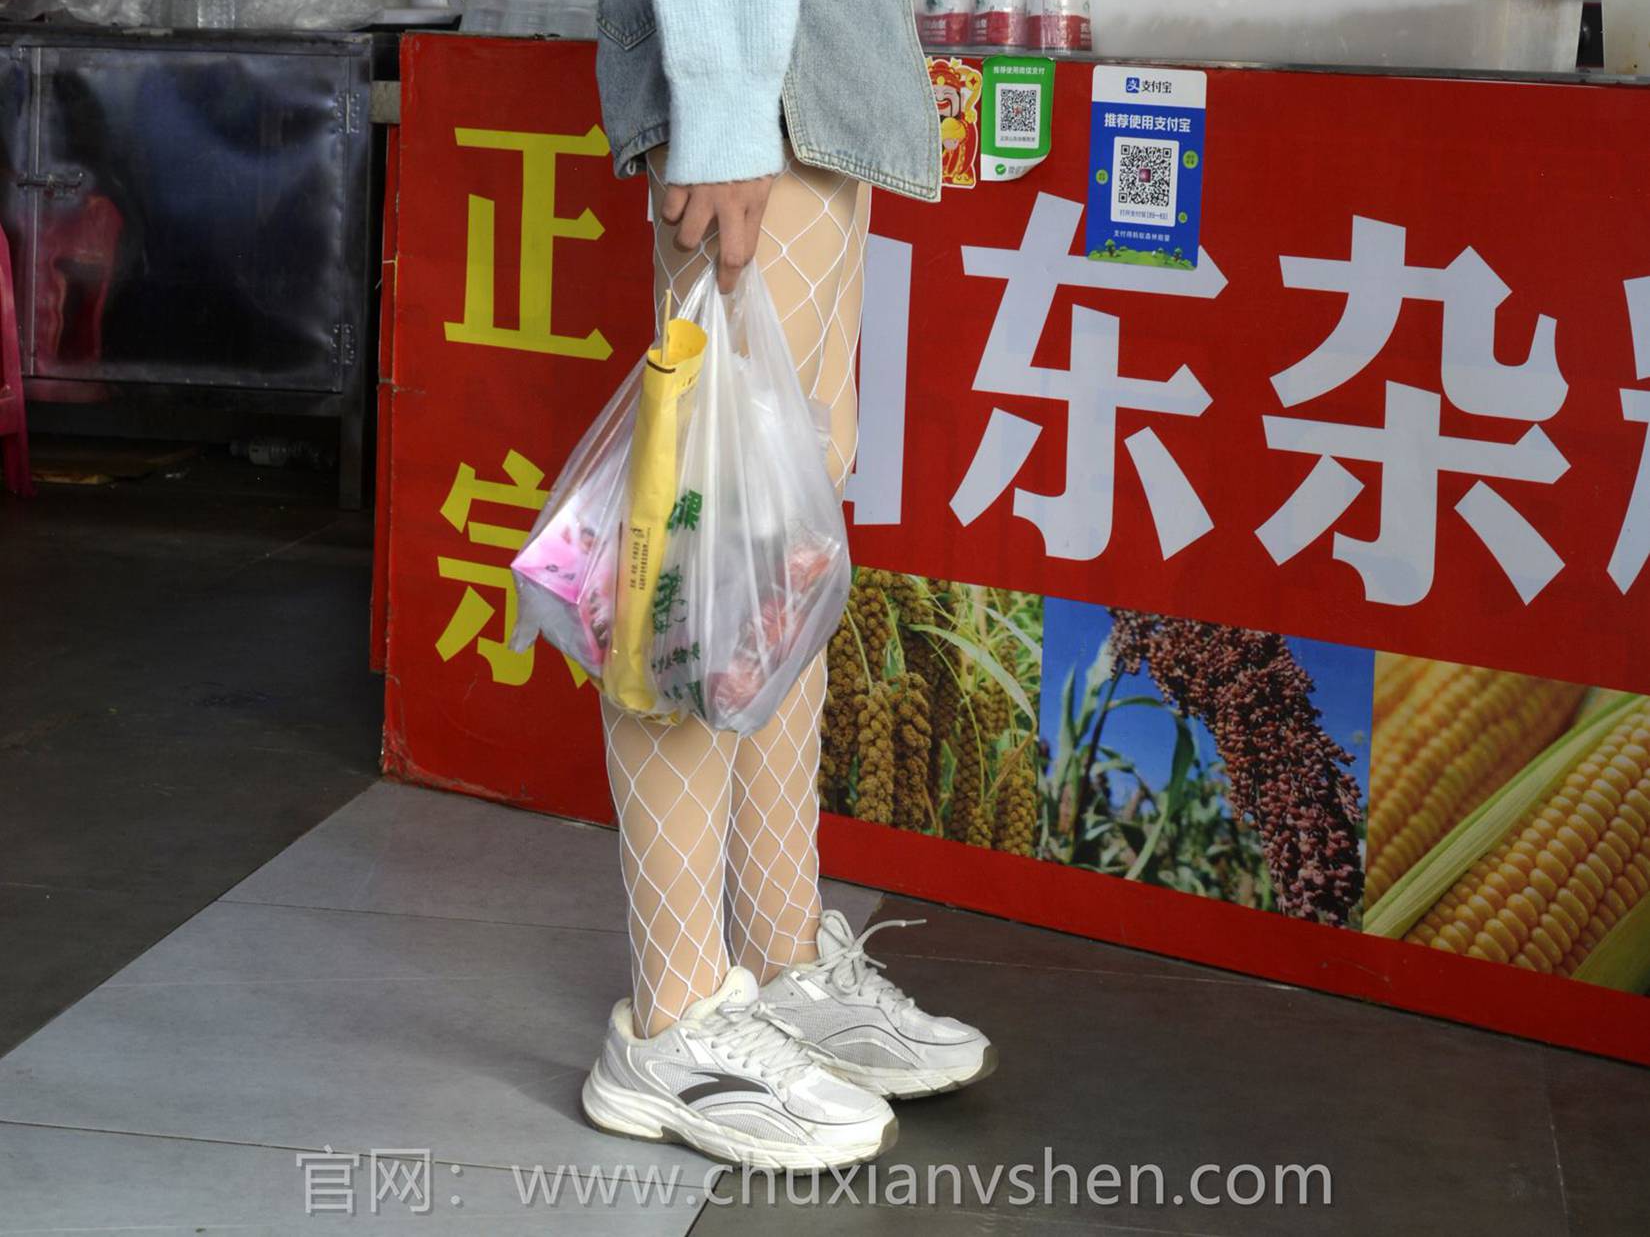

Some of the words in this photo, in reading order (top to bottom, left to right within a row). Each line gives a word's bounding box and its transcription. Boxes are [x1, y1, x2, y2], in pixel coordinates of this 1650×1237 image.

[1104, 112, 1192, 133] 推荐使用支付宝
[1142, 80, 1173, 94] 支付宝
[435, 123, 614, 689] 正宗
[842, 189, 1650, 607] 东杂
